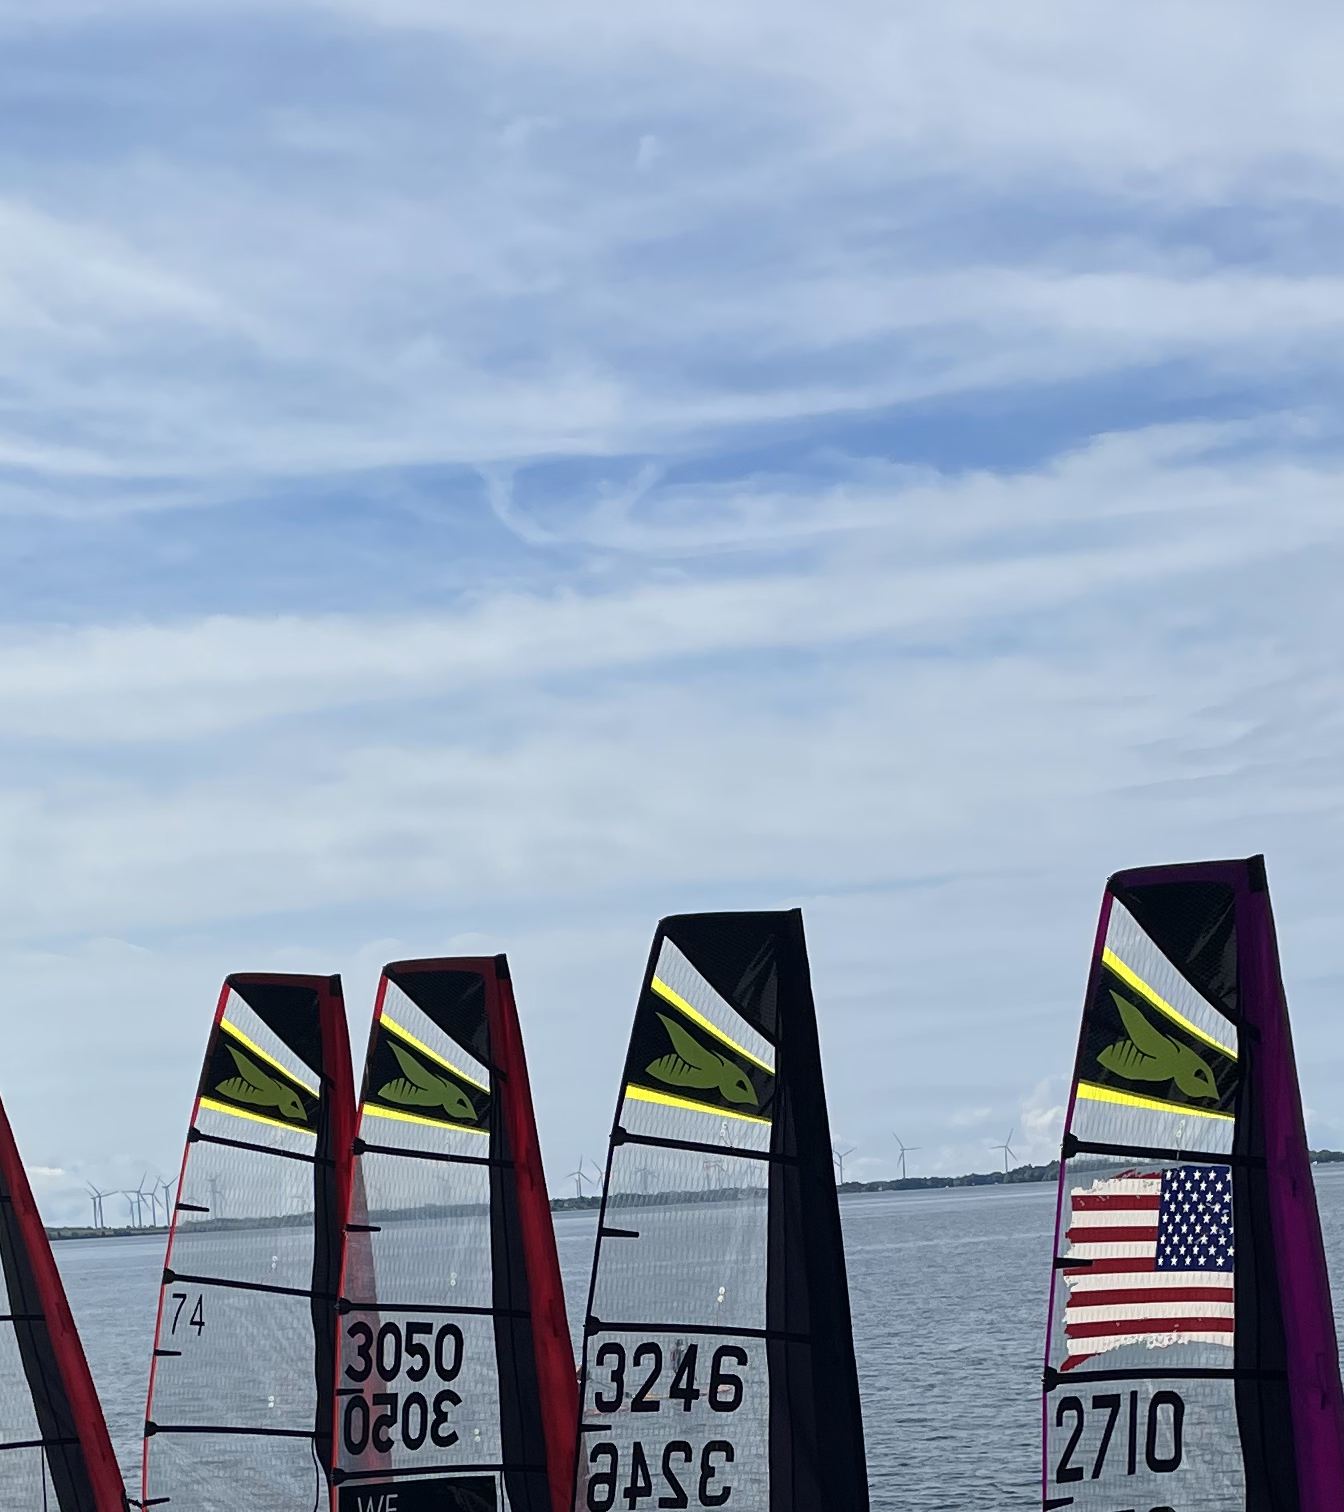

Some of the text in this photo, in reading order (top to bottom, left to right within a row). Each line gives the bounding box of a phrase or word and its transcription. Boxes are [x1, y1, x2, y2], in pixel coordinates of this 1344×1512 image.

[171, 1292, 206, 1336] 74
[344, 1320, 465, 1383] 3050
[593, 1341, 749, 1413] 3246
[1055, 1389, 1186, 1484] 2710
